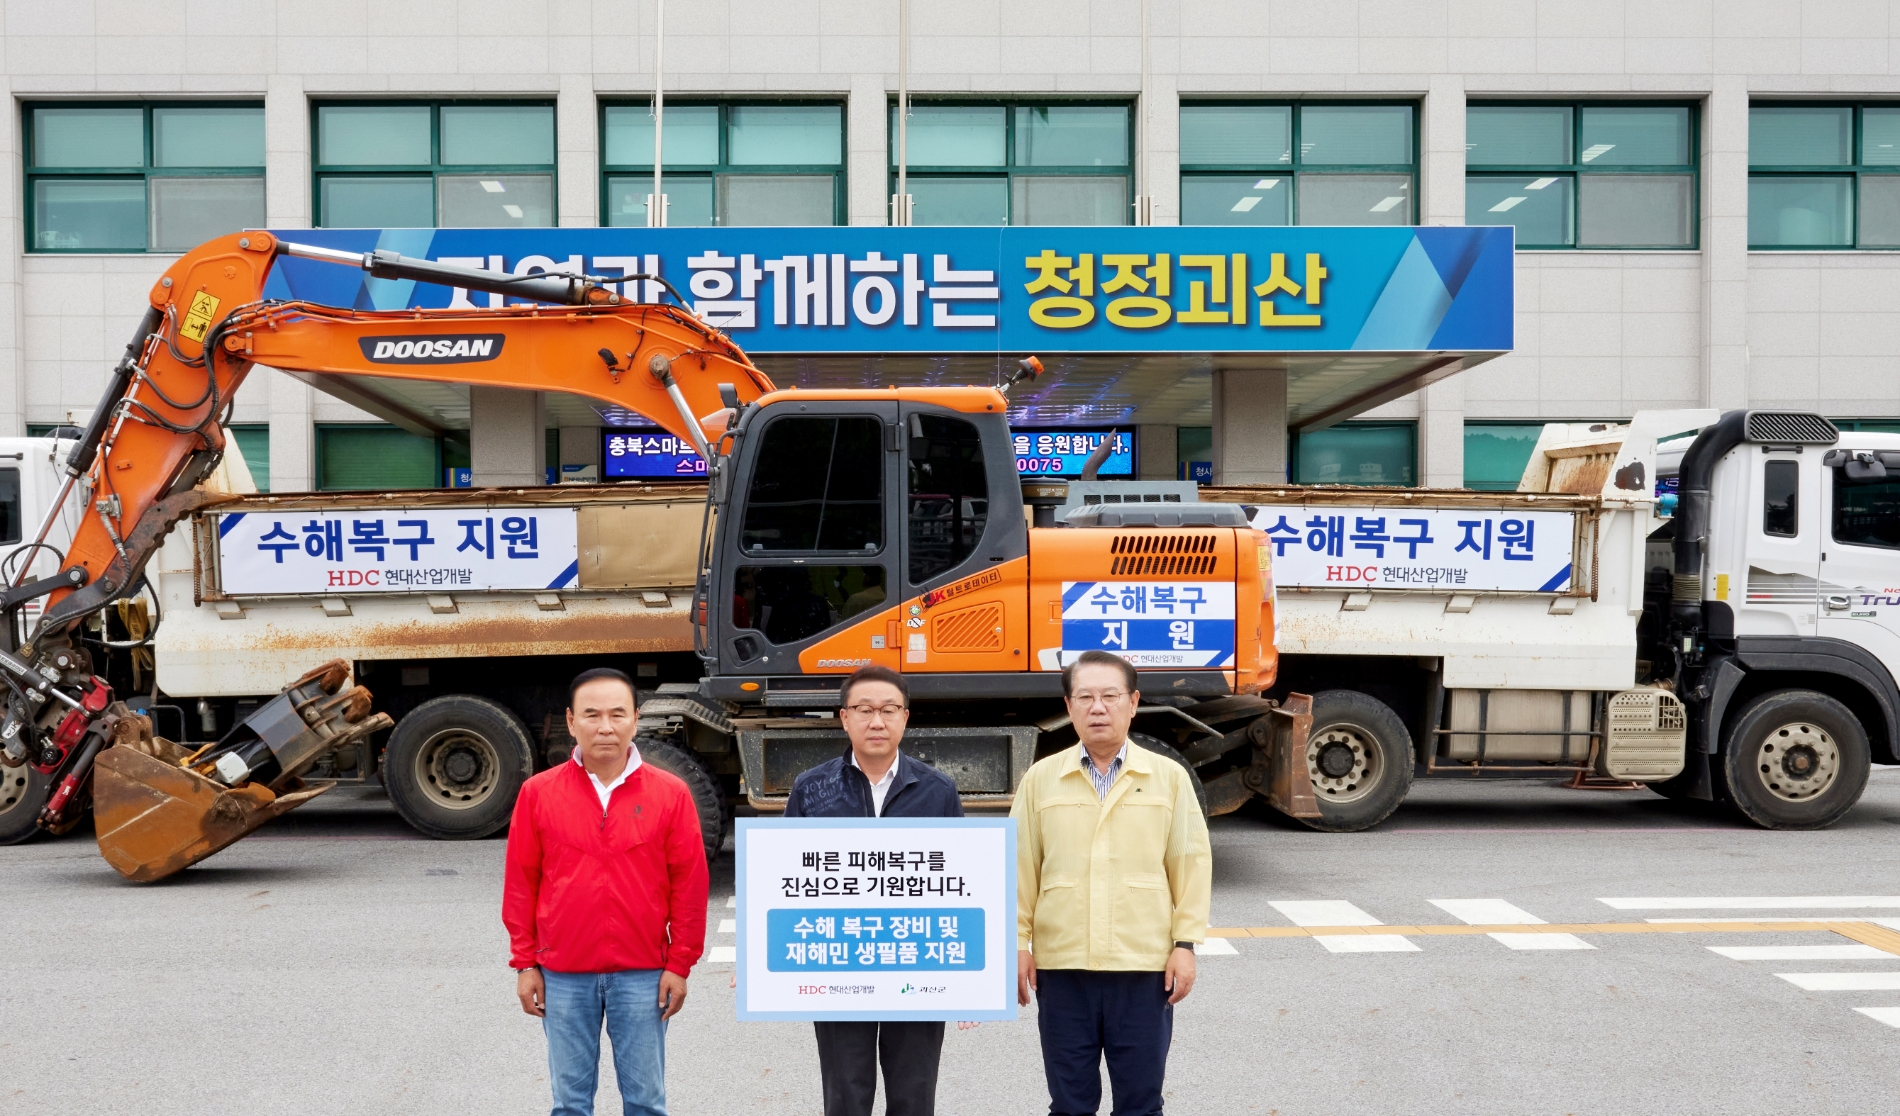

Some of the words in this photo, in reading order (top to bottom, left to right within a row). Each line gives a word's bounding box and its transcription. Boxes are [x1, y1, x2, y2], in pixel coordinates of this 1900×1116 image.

[686, 250, 999, 328] 함께하는
[1025, 250, 1328, 328] 청정괴산
[373, 339, 494, 359] DOOSAN
[1016, 458, 1062, 471] 0075
[257, 516, 435, 563] 수해복구
[457, 516, 539, 560] 지원
[1264, 515, 1434, 560] 수해복구
[1454, 518, 1535, 562] 지원
[328, 569, 380, 587] HDC
[384, 568, 473, 586] 현대산업개발
[1326, 565, 1378, 583] HDC
[1382, 566, 1469, 584] 현대산업개발
[1090, 585, 1207, 615] 수해복구
[1122, 654, 1139, 664] DC
[1140, 654, 1184, 664] 현대산업개발
[802, 851, 842, 872] 빠른
[847, 851, 946, 872] 피해복구를
[781, 877, 860, 898] 진심으로
[866, 876, 971, 897] 기원합니다.
[793, 916, 835, 939] 수해
[842, 917, 884, 939] 복구
[889, 916, 931, 939] 장비
[938, 916, 958, 938] 및
[785, 942, 849, 965] 재해민
[855, 942, 919, 965] 생필품
[924, 941, 966, 964] 지원
[798, 985, 827, 995] HDC
[828, 985, 875, 995] 현대산업개발
